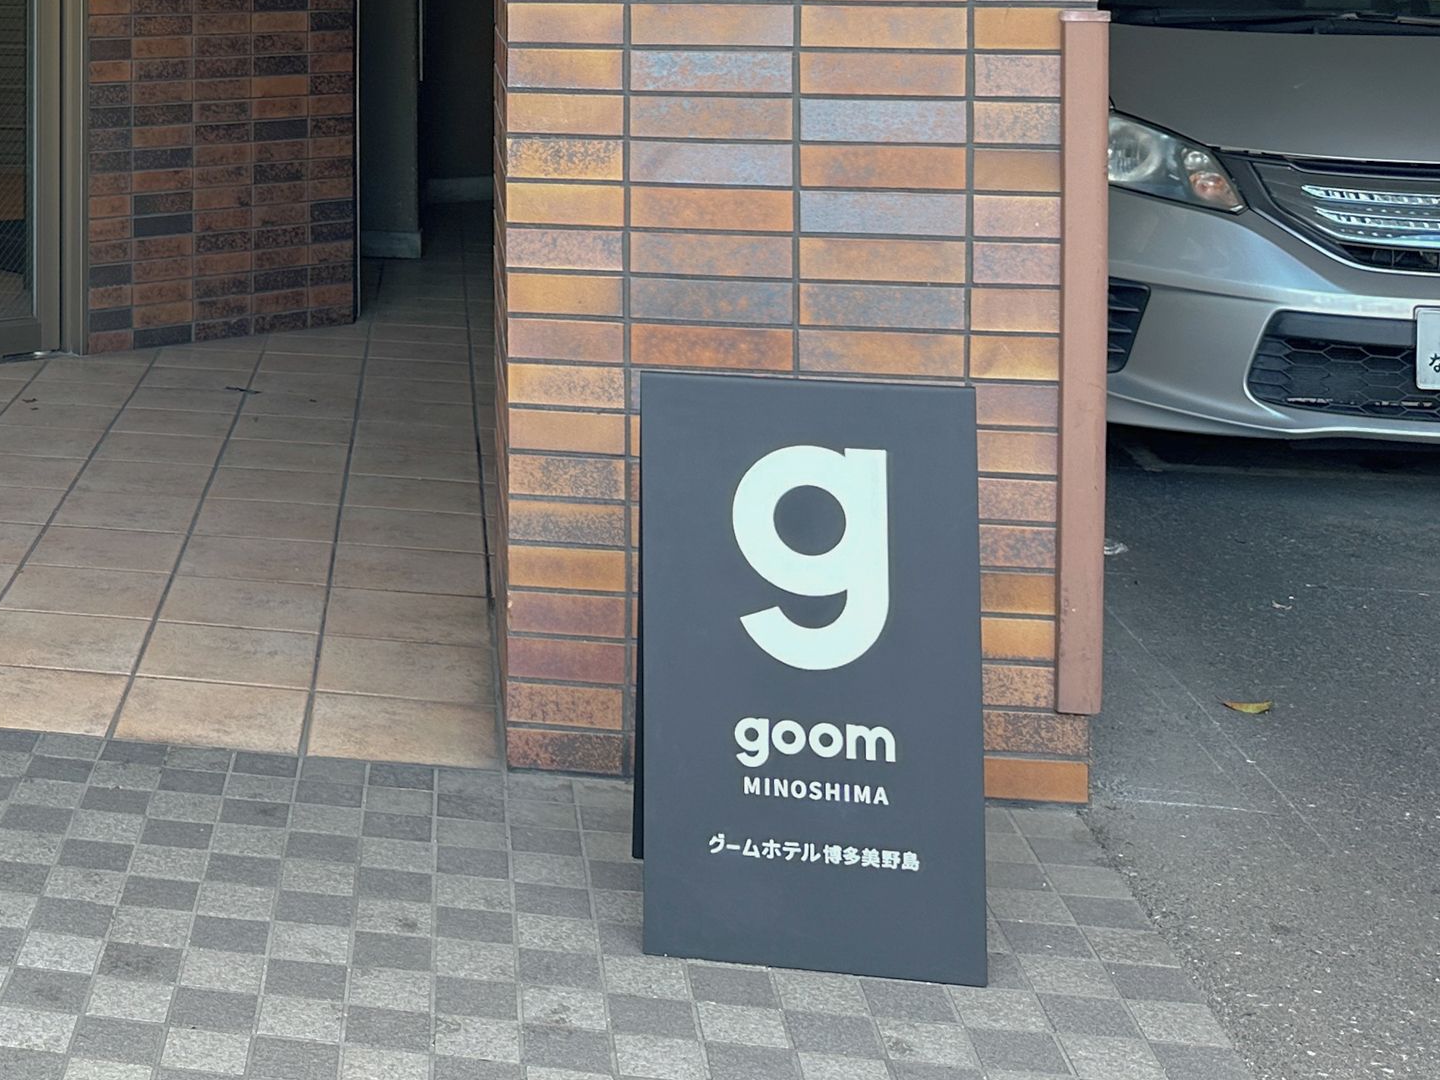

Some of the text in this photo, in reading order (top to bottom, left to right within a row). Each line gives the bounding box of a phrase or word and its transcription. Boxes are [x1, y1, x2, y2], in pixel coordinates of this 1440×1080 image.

[732, 445, 890, 671] g
[734, 716, 896, 768] goom
[743, 776, 890, 806] MINOSHIMA
